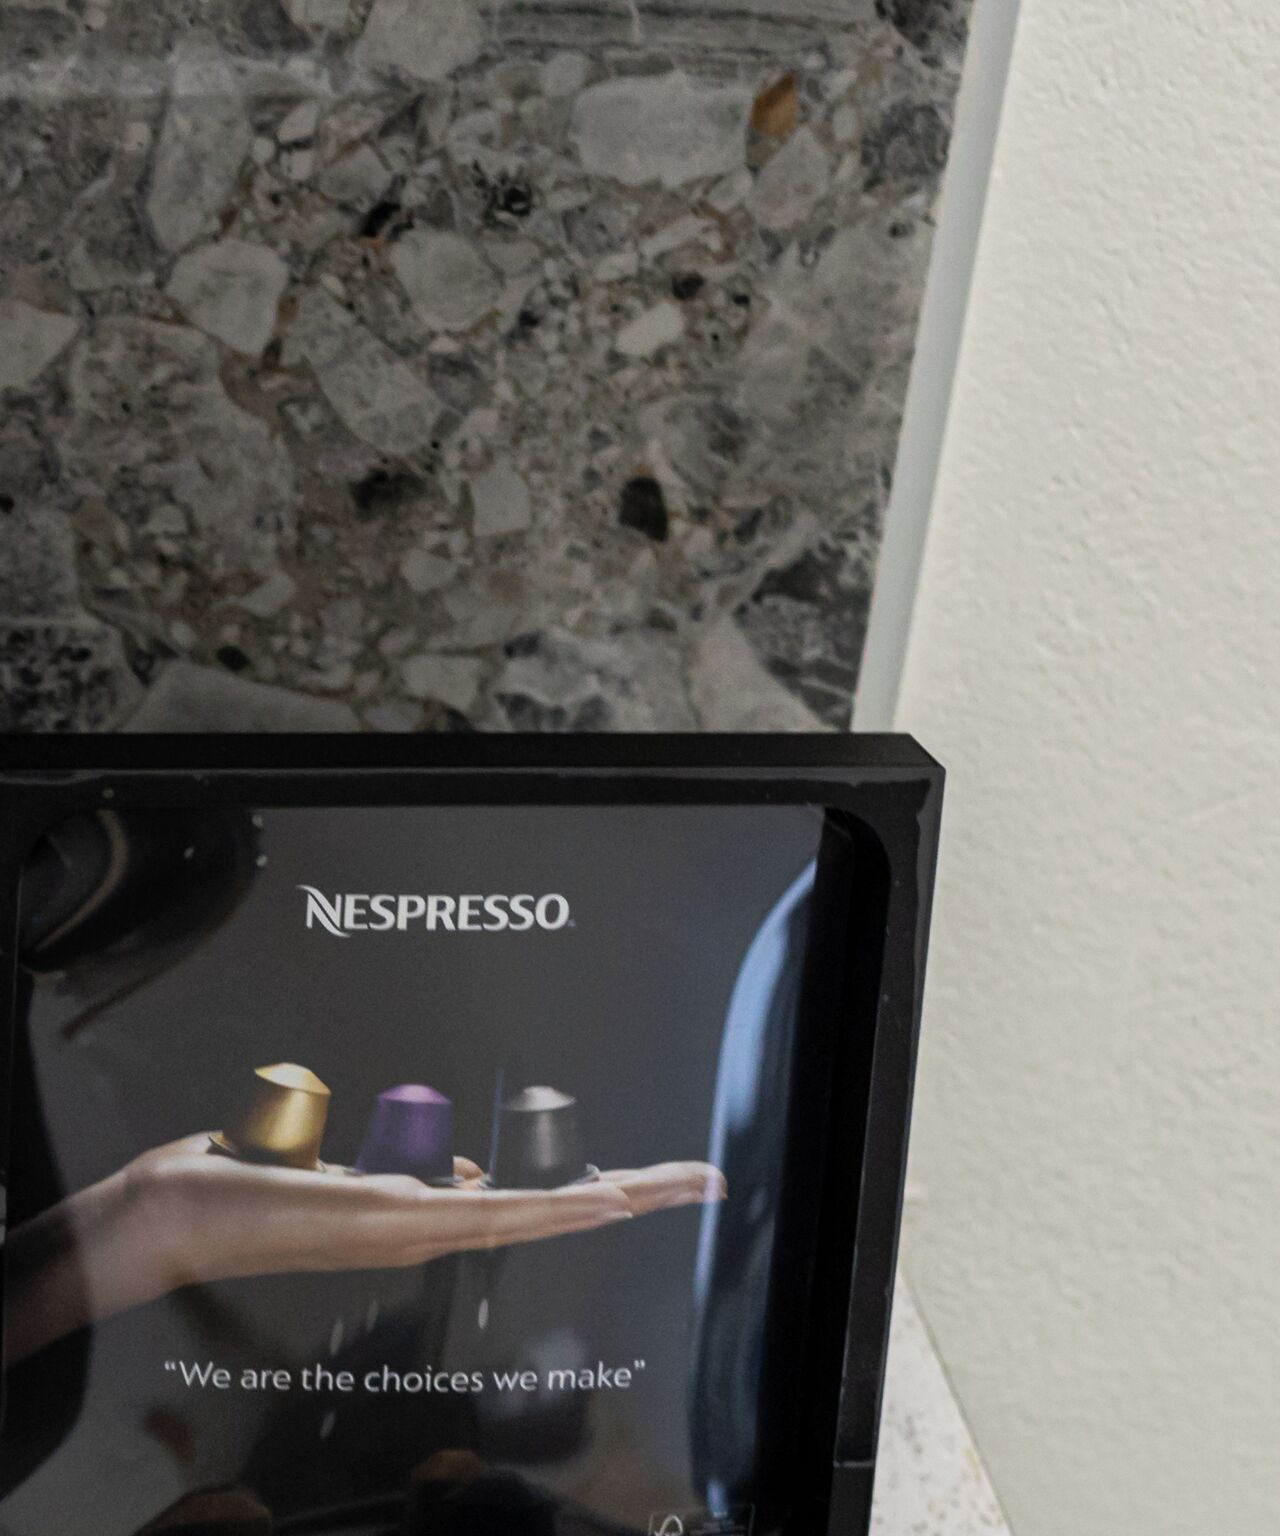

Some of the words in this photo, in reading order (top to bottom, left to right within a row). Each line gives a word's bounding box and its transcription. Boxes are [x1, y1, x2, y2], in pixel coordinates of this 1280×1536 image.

[295, 884, 571, 938] NESPRESSO
[240, 1369, 291, 1390] are
[302, 1363, 354, 1391] the
[363, 1363, 483, 1393] choices
[492, 1370, 538, 1391] we
